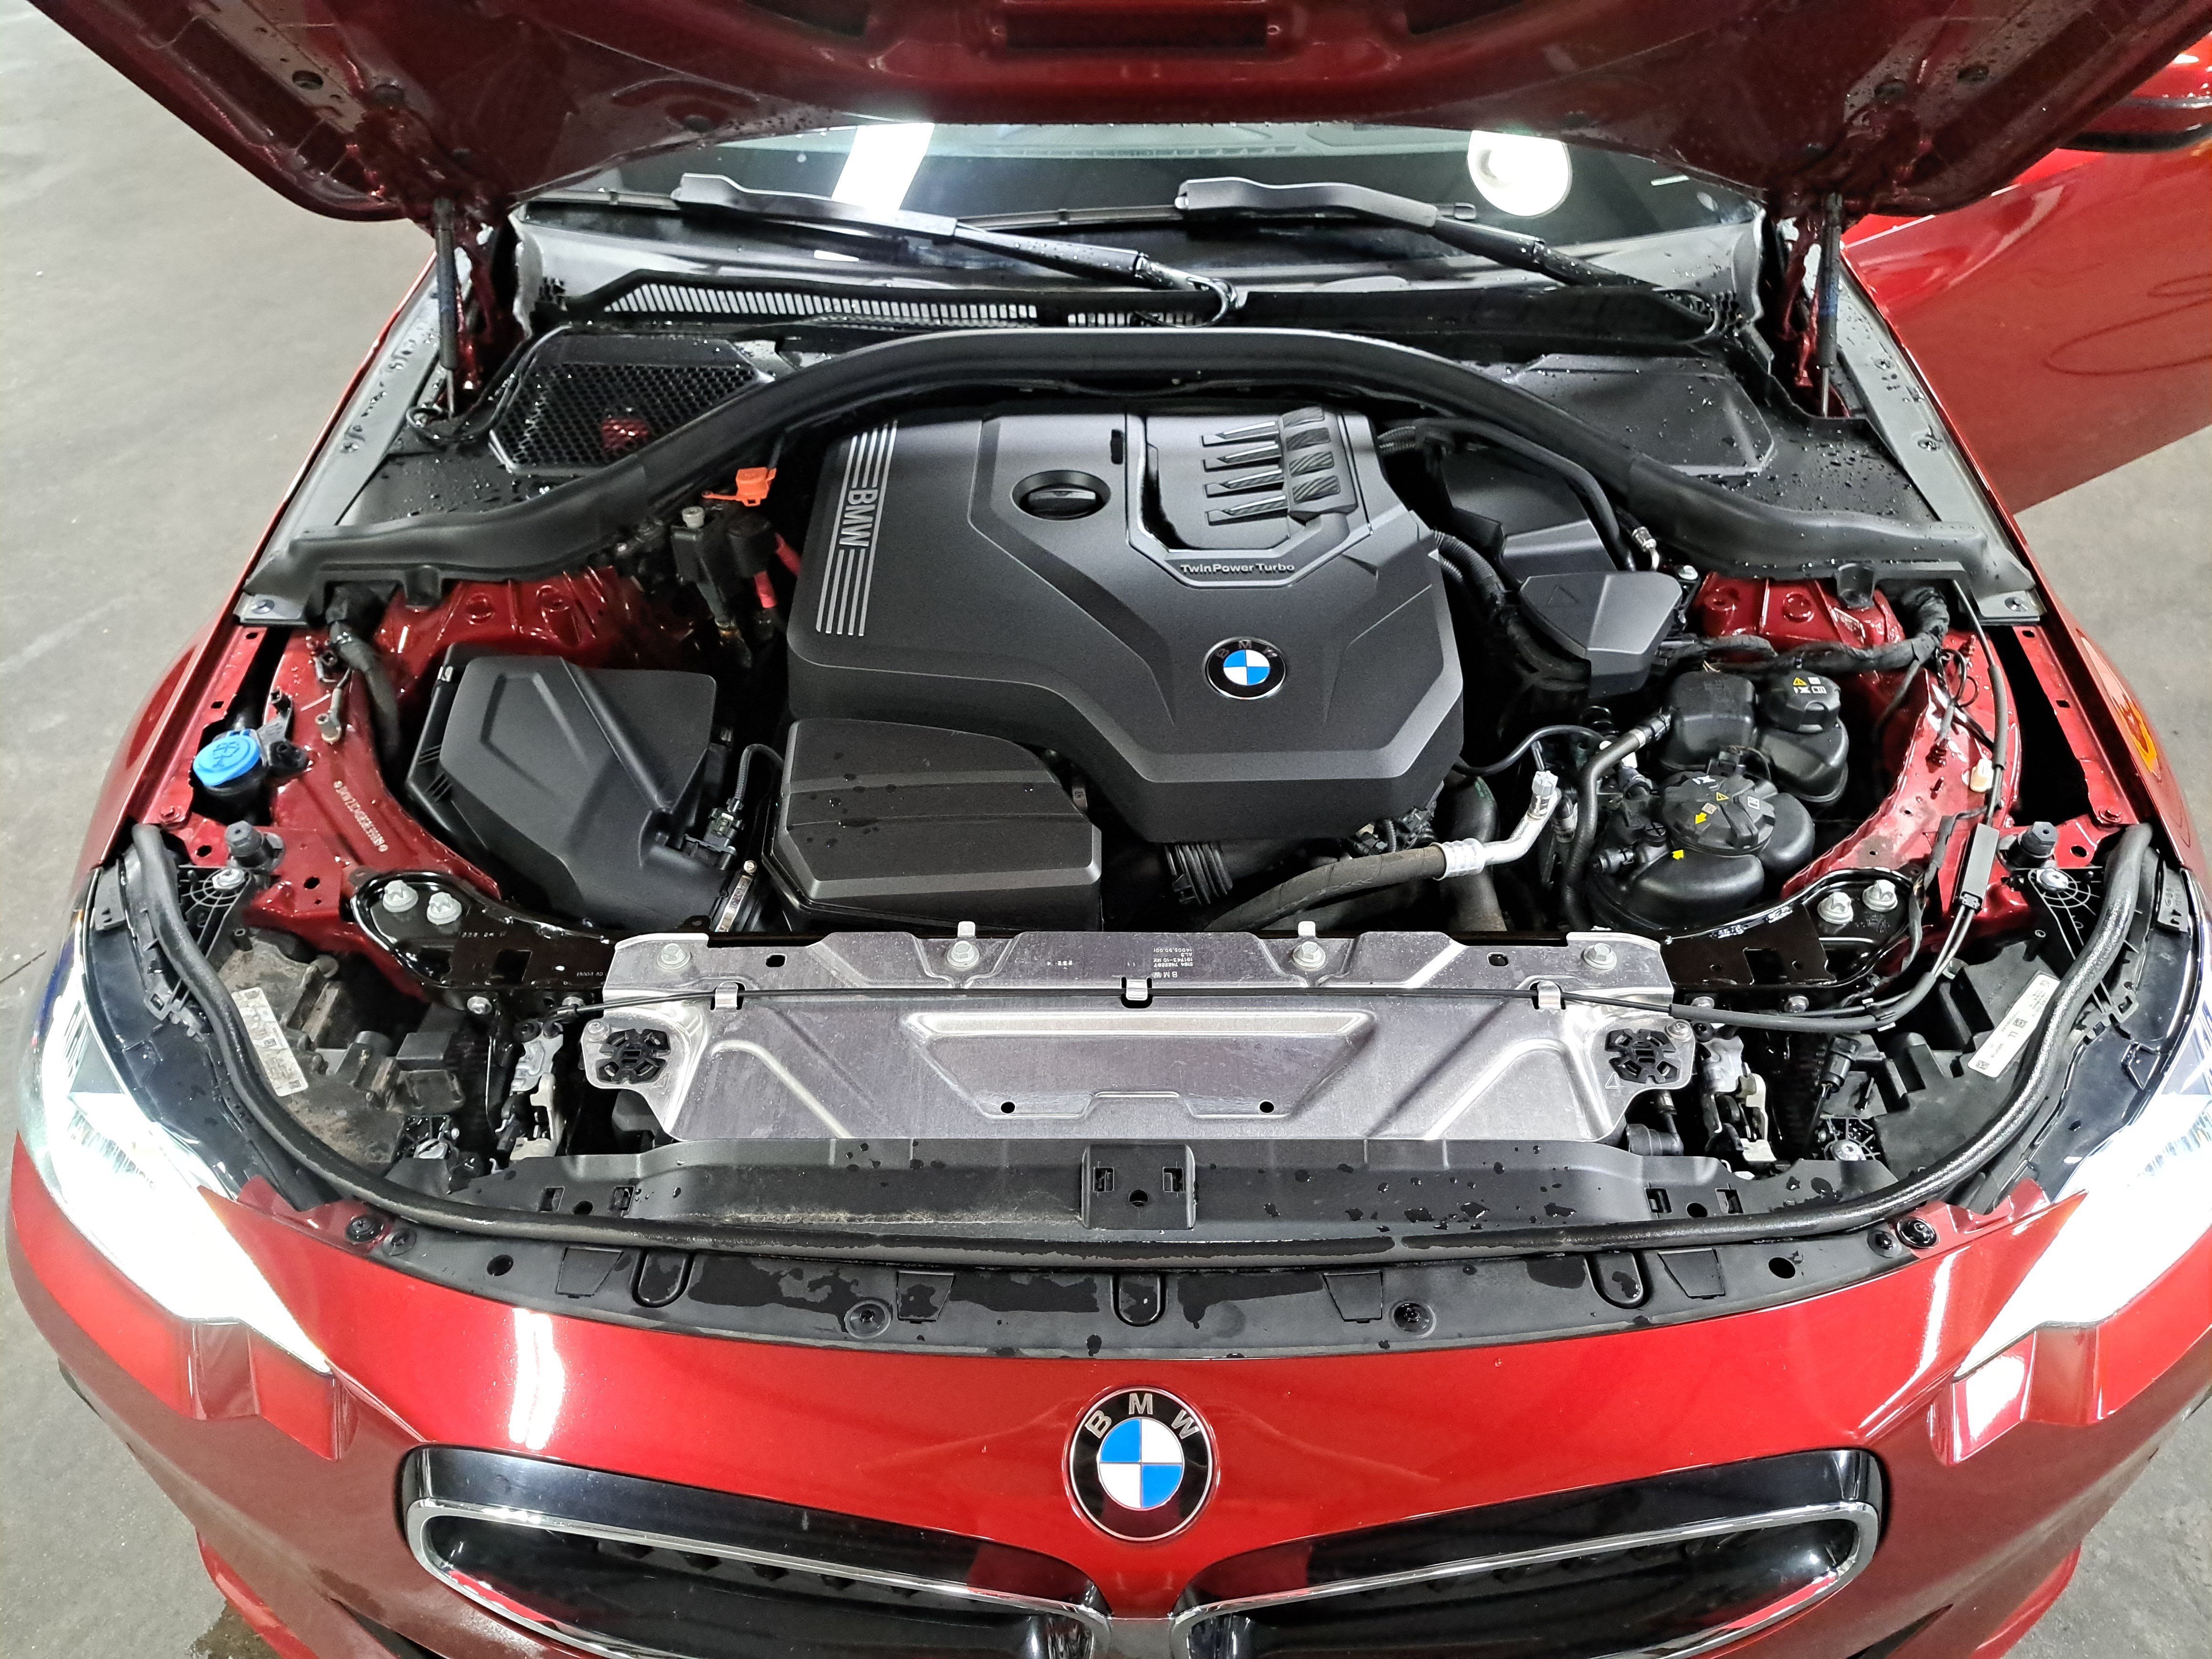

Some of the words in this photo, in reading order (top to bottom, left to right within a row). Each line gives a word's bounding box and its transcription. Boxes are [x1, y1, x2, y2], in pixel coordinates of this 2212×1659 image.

[839, 489, 878, 546] BMW
[1179, 563, 1254, 573] TwinPower
[1255, 563, 1295, 573] Turbo
[1216, 640, 1278, 659] BMW
[1084, 1393, 1200, 1440] BMW
